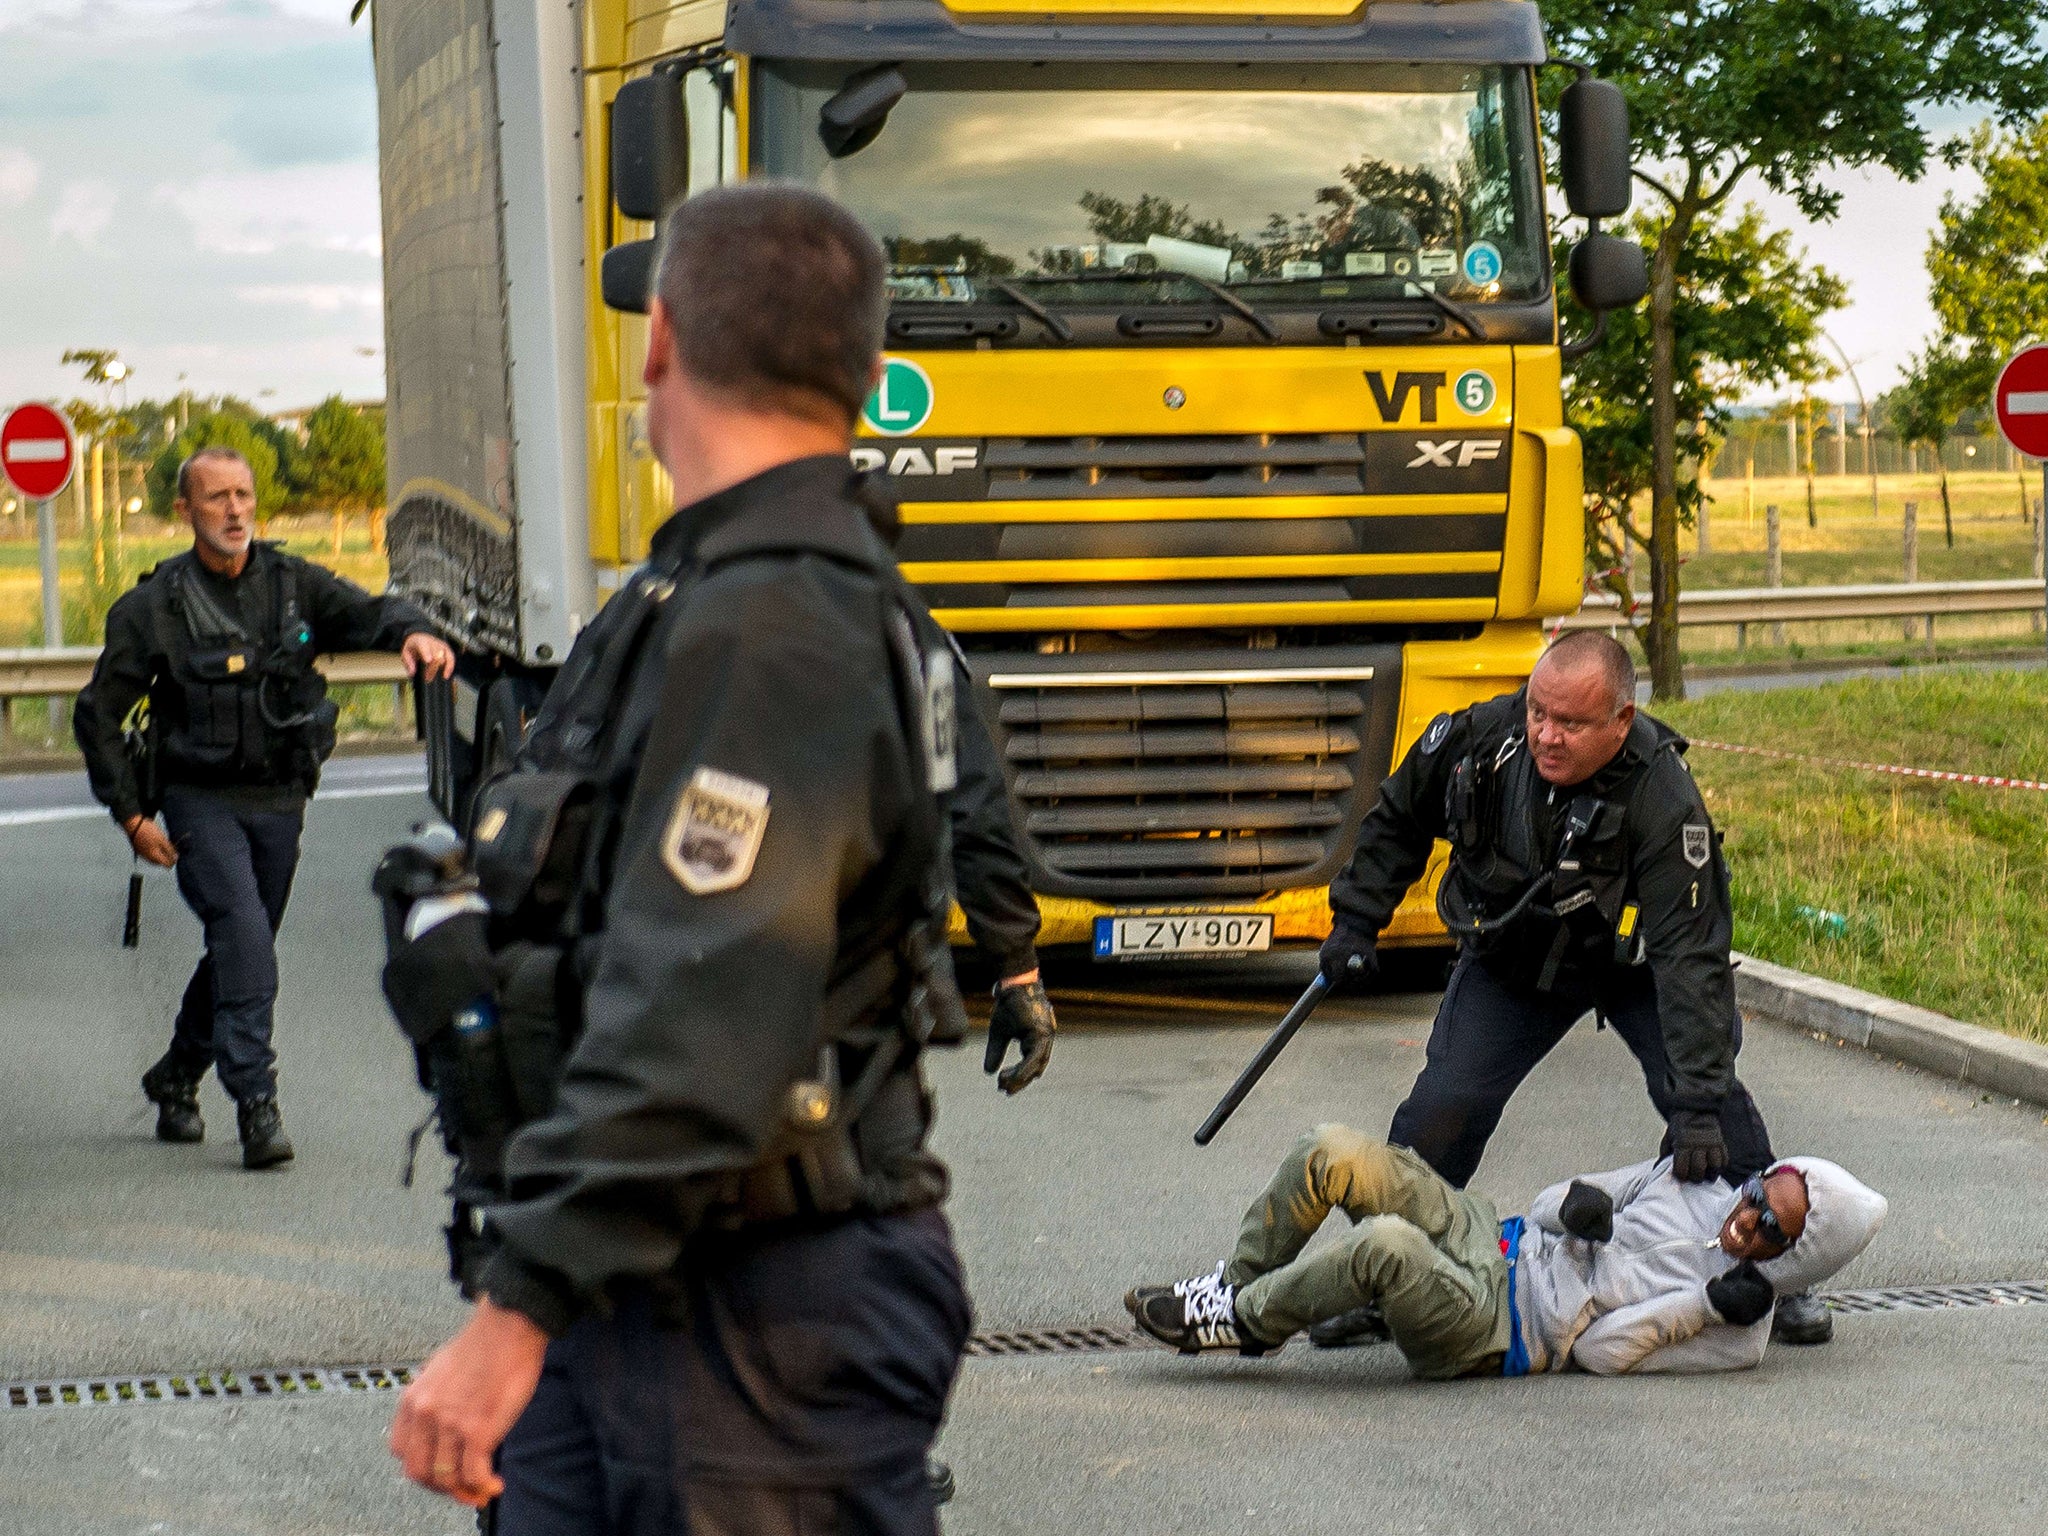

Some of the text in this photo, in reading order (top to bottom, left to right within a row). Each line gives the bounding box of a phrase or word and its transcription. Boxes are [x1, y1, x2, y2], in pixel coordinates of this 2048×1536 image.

[879, 371, 911, 421] L
[1364, 371, 1446, 422] VT
[1466, 378, 1484, 407] 5
[849, 447, 978, 475] DAF
[1406, 439, 1503, 468] XF
